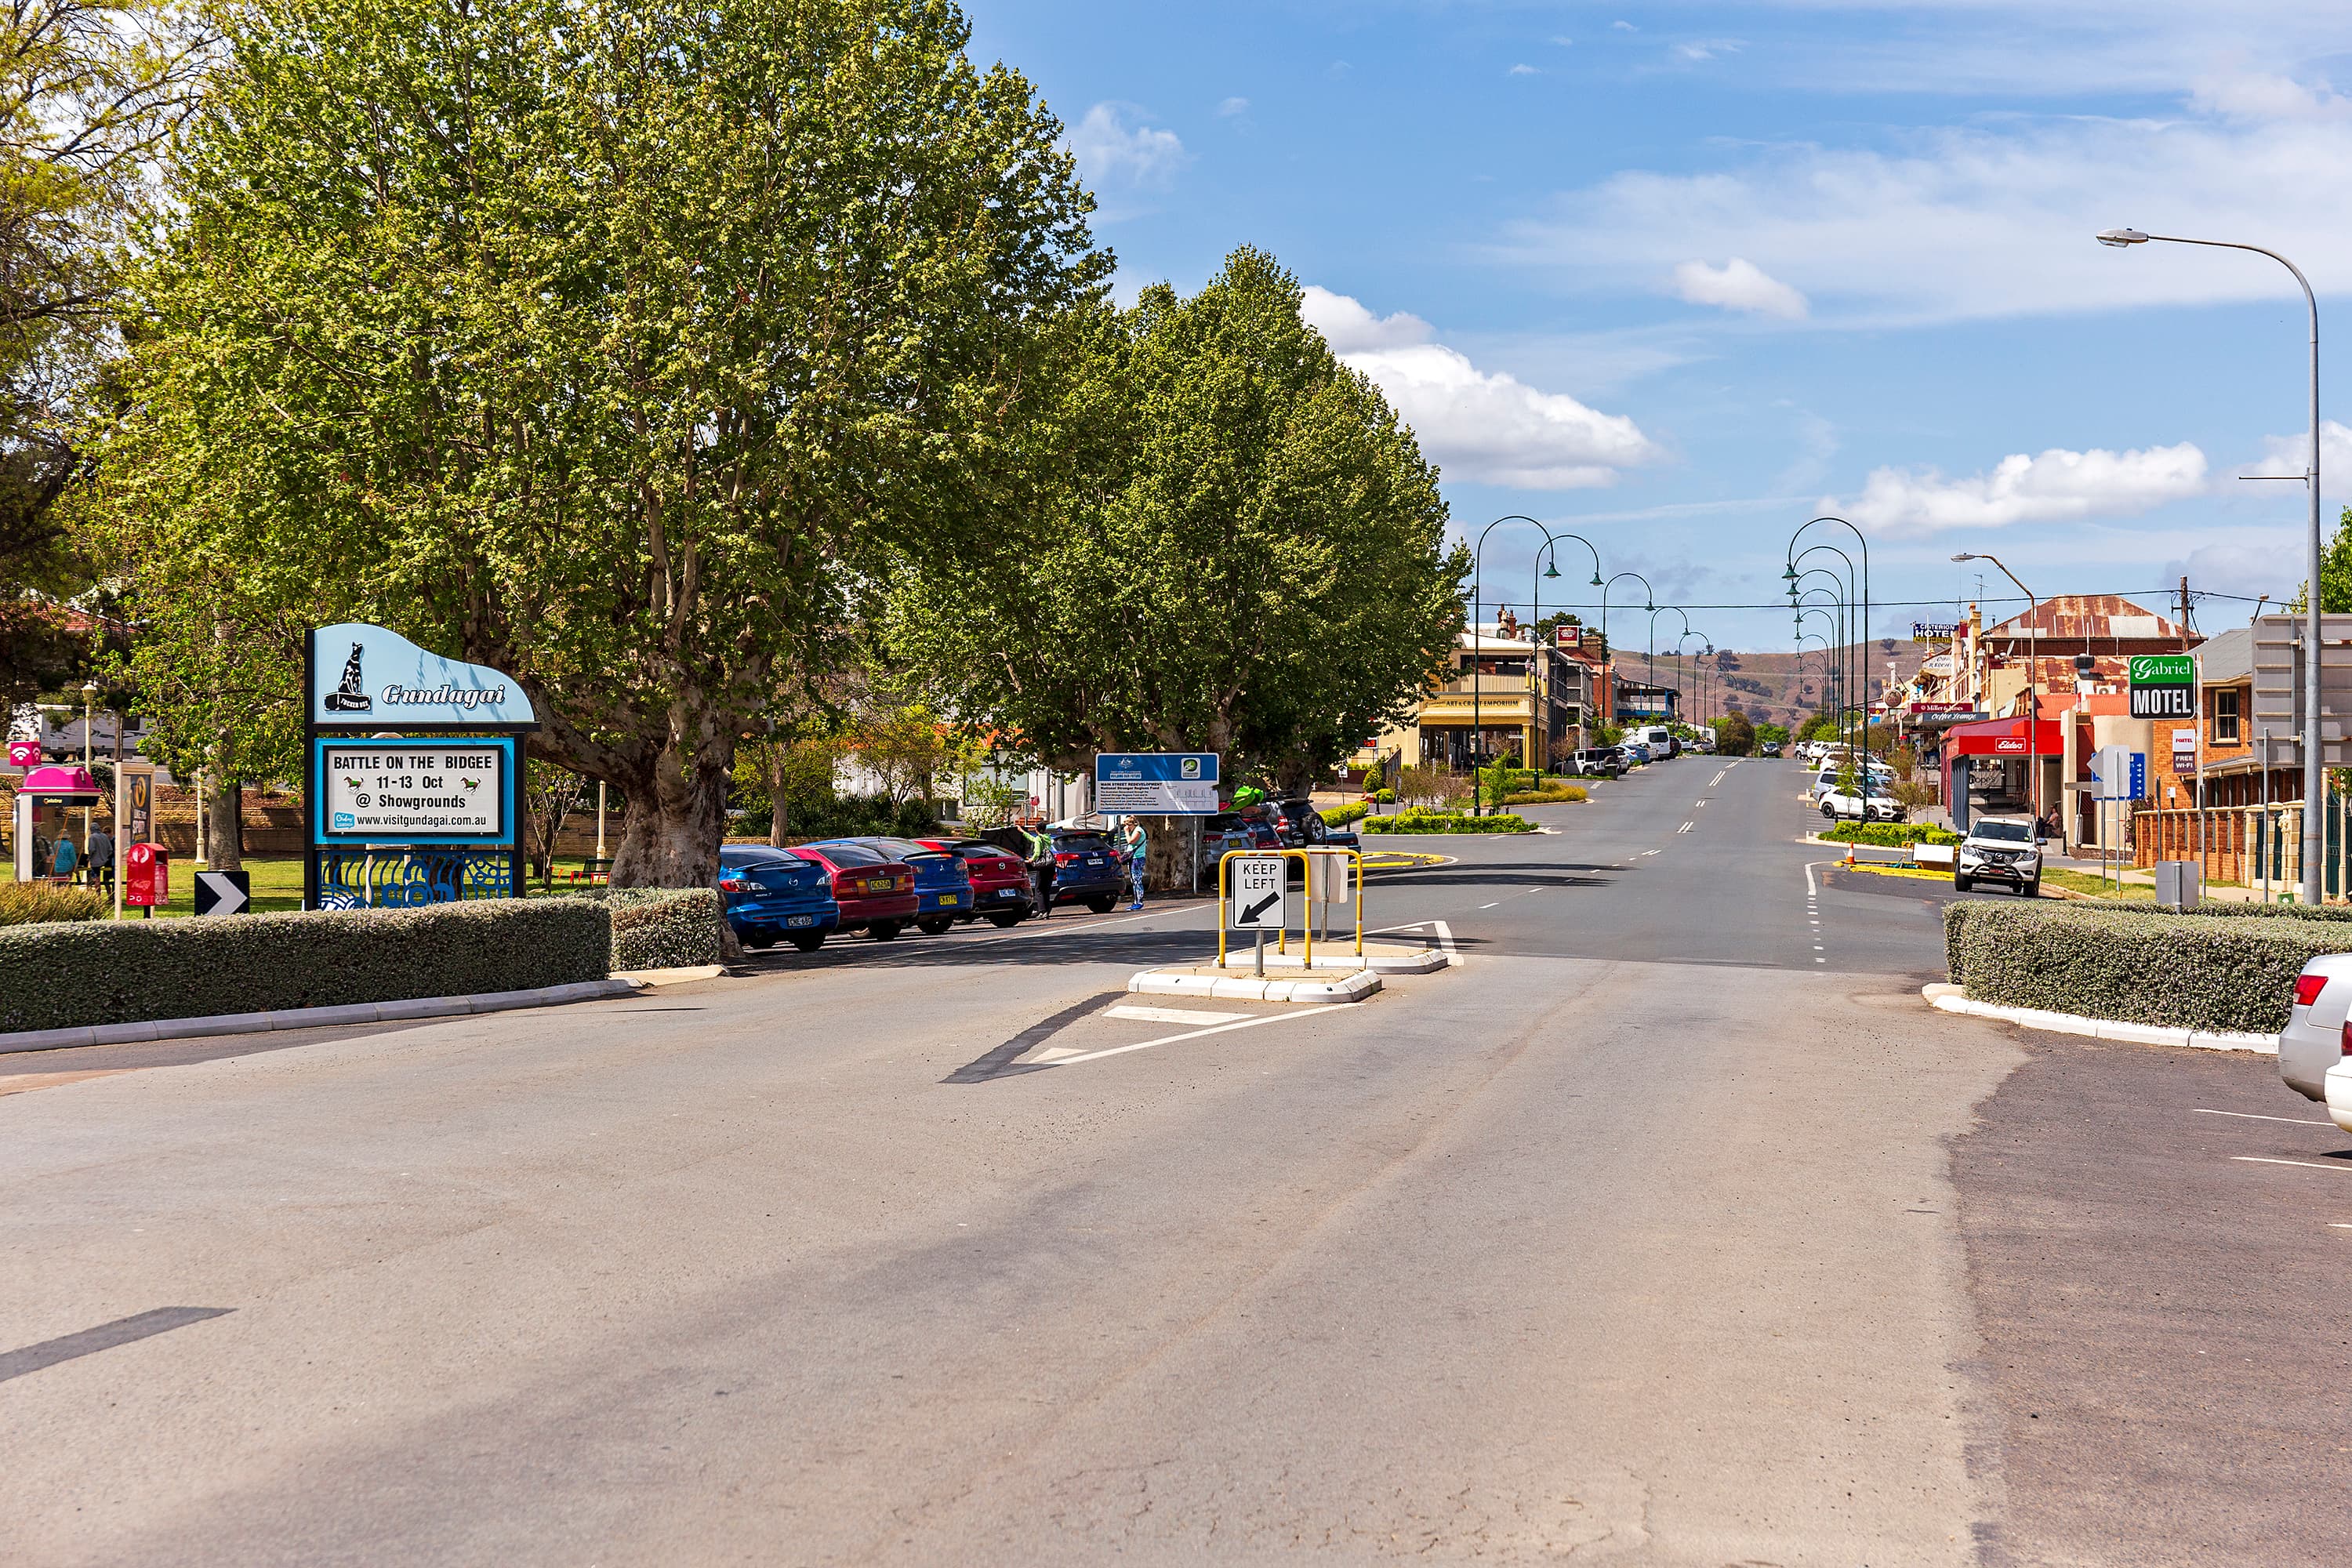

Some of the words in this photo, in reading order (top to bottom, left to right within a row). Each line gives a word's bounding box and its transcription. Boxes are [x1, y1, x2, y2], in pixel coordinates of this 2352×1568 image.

[2132, 659, 2190, 680] Gabriel
[340, 698, 359, 708] TUCKER
[382, 684, 506, 709] Gundagai
[2133, 689, 2191, 714] MOTEL
[1998, 740, 2024, 750] Elders
[334, 756, 380, 769] BATTLE
[386, 756, 403, 768] ON
[408, 756, 434, 768] THE
[445, 756, 492, 769] BIDGEE
[376, 775, 412, 789] 11-13
[423, 775, 443, 789] Oct
[356, 793, 371, 808] @
[379, 794, 466, 810] Showgrounds
[357, 814, 487, 828] www.visitgundagai.com.au
[1243, 863, 1277, 875] KEEP
[1244, 878, 1276, 890] LEFT
[129, 895, 154, 903] POST
